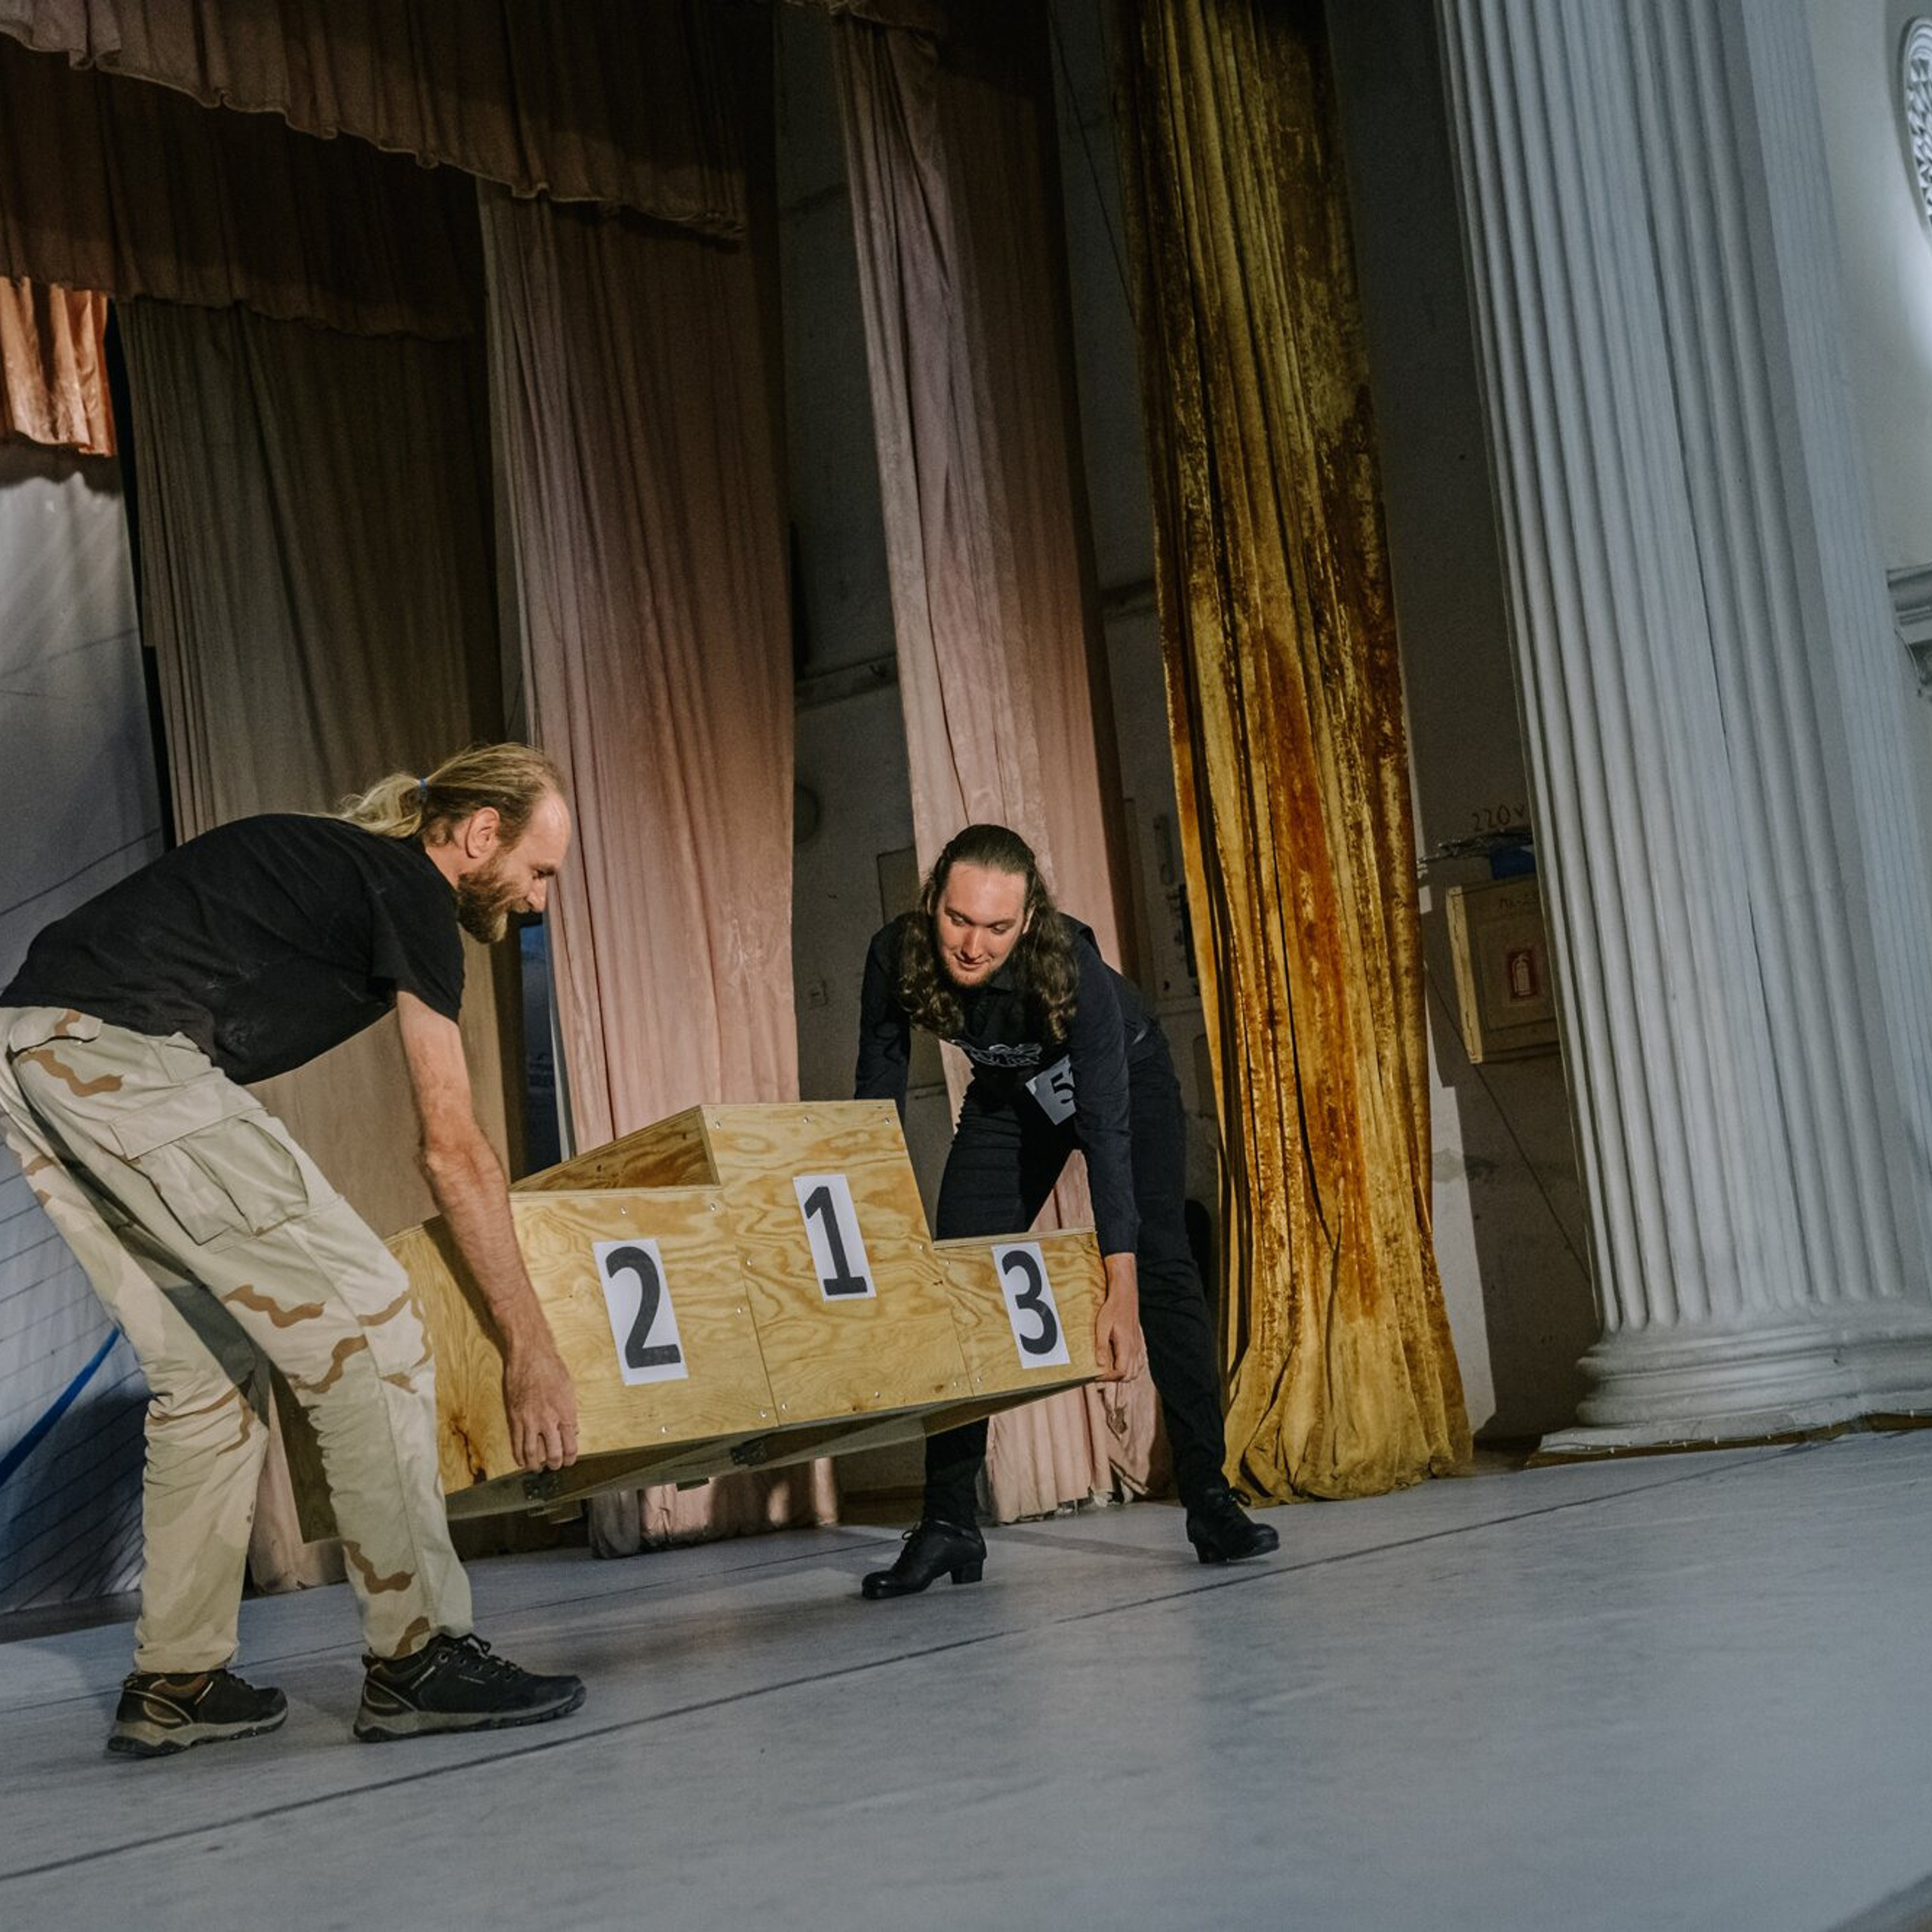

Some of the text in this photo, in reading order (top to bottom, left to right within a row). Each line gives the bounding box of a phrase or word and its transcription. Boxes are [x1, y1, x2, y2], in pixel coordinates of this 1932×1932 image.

[804, 1186, 868, 1297] 1
[605, 1246, 681, 1369] 2
[1001, 1250, 1058, 1355] 3
